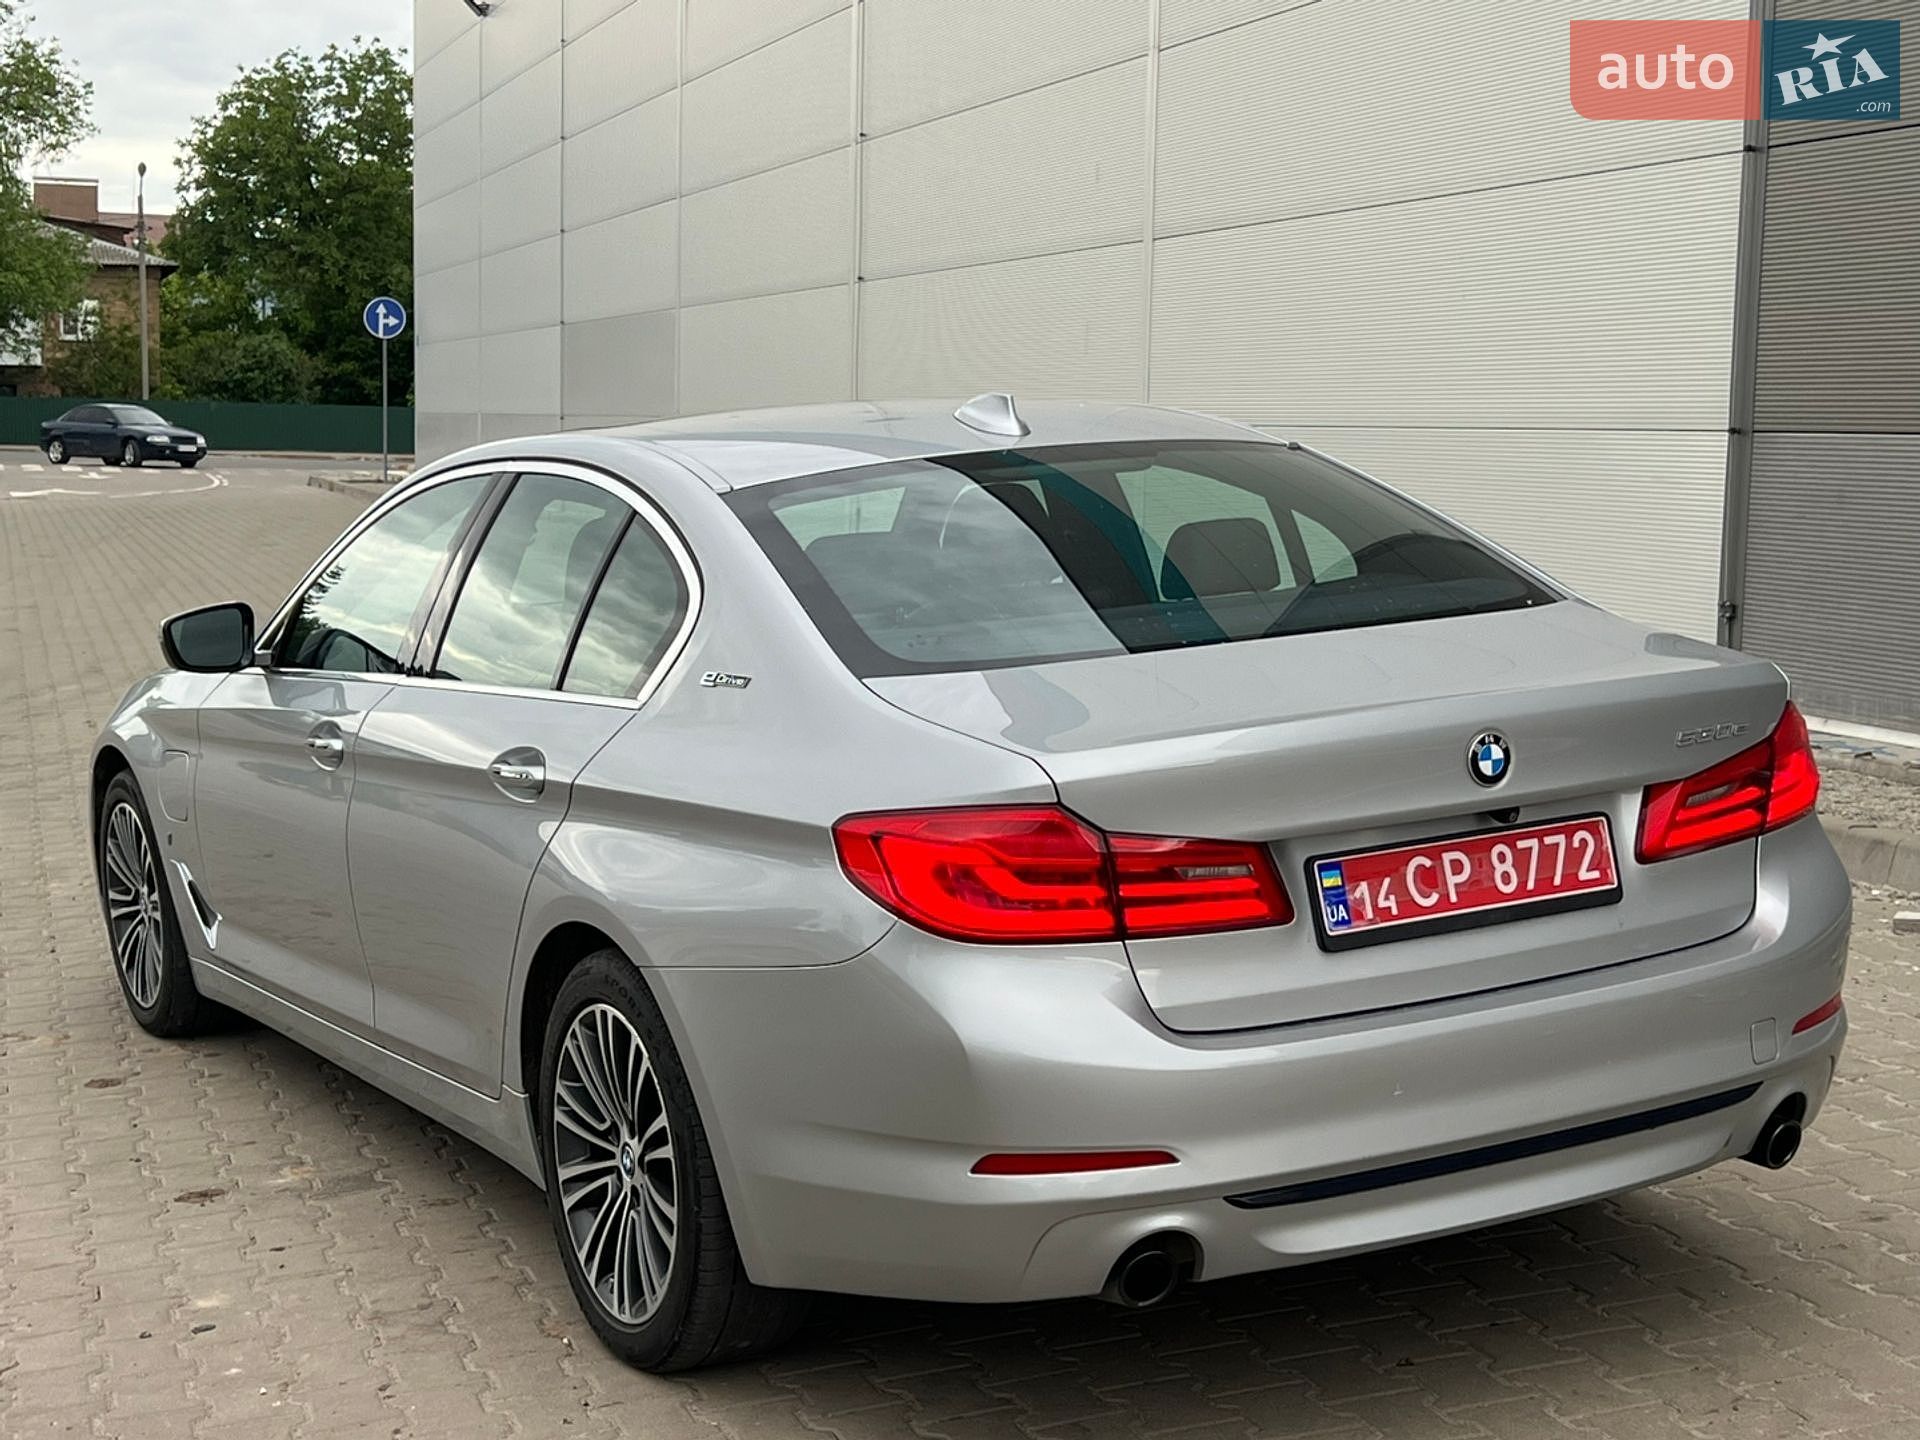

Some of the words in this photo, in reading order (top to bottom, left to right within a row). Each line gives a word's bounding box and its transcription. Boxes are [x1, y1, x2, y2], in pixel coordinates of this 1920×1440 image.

[1353, 876, 1399, 920] 14
[1405, 850, 1472, 908] CP
[1489, 829, 1602, 895] 8772
[1326, 903, 1349, 922] UA
